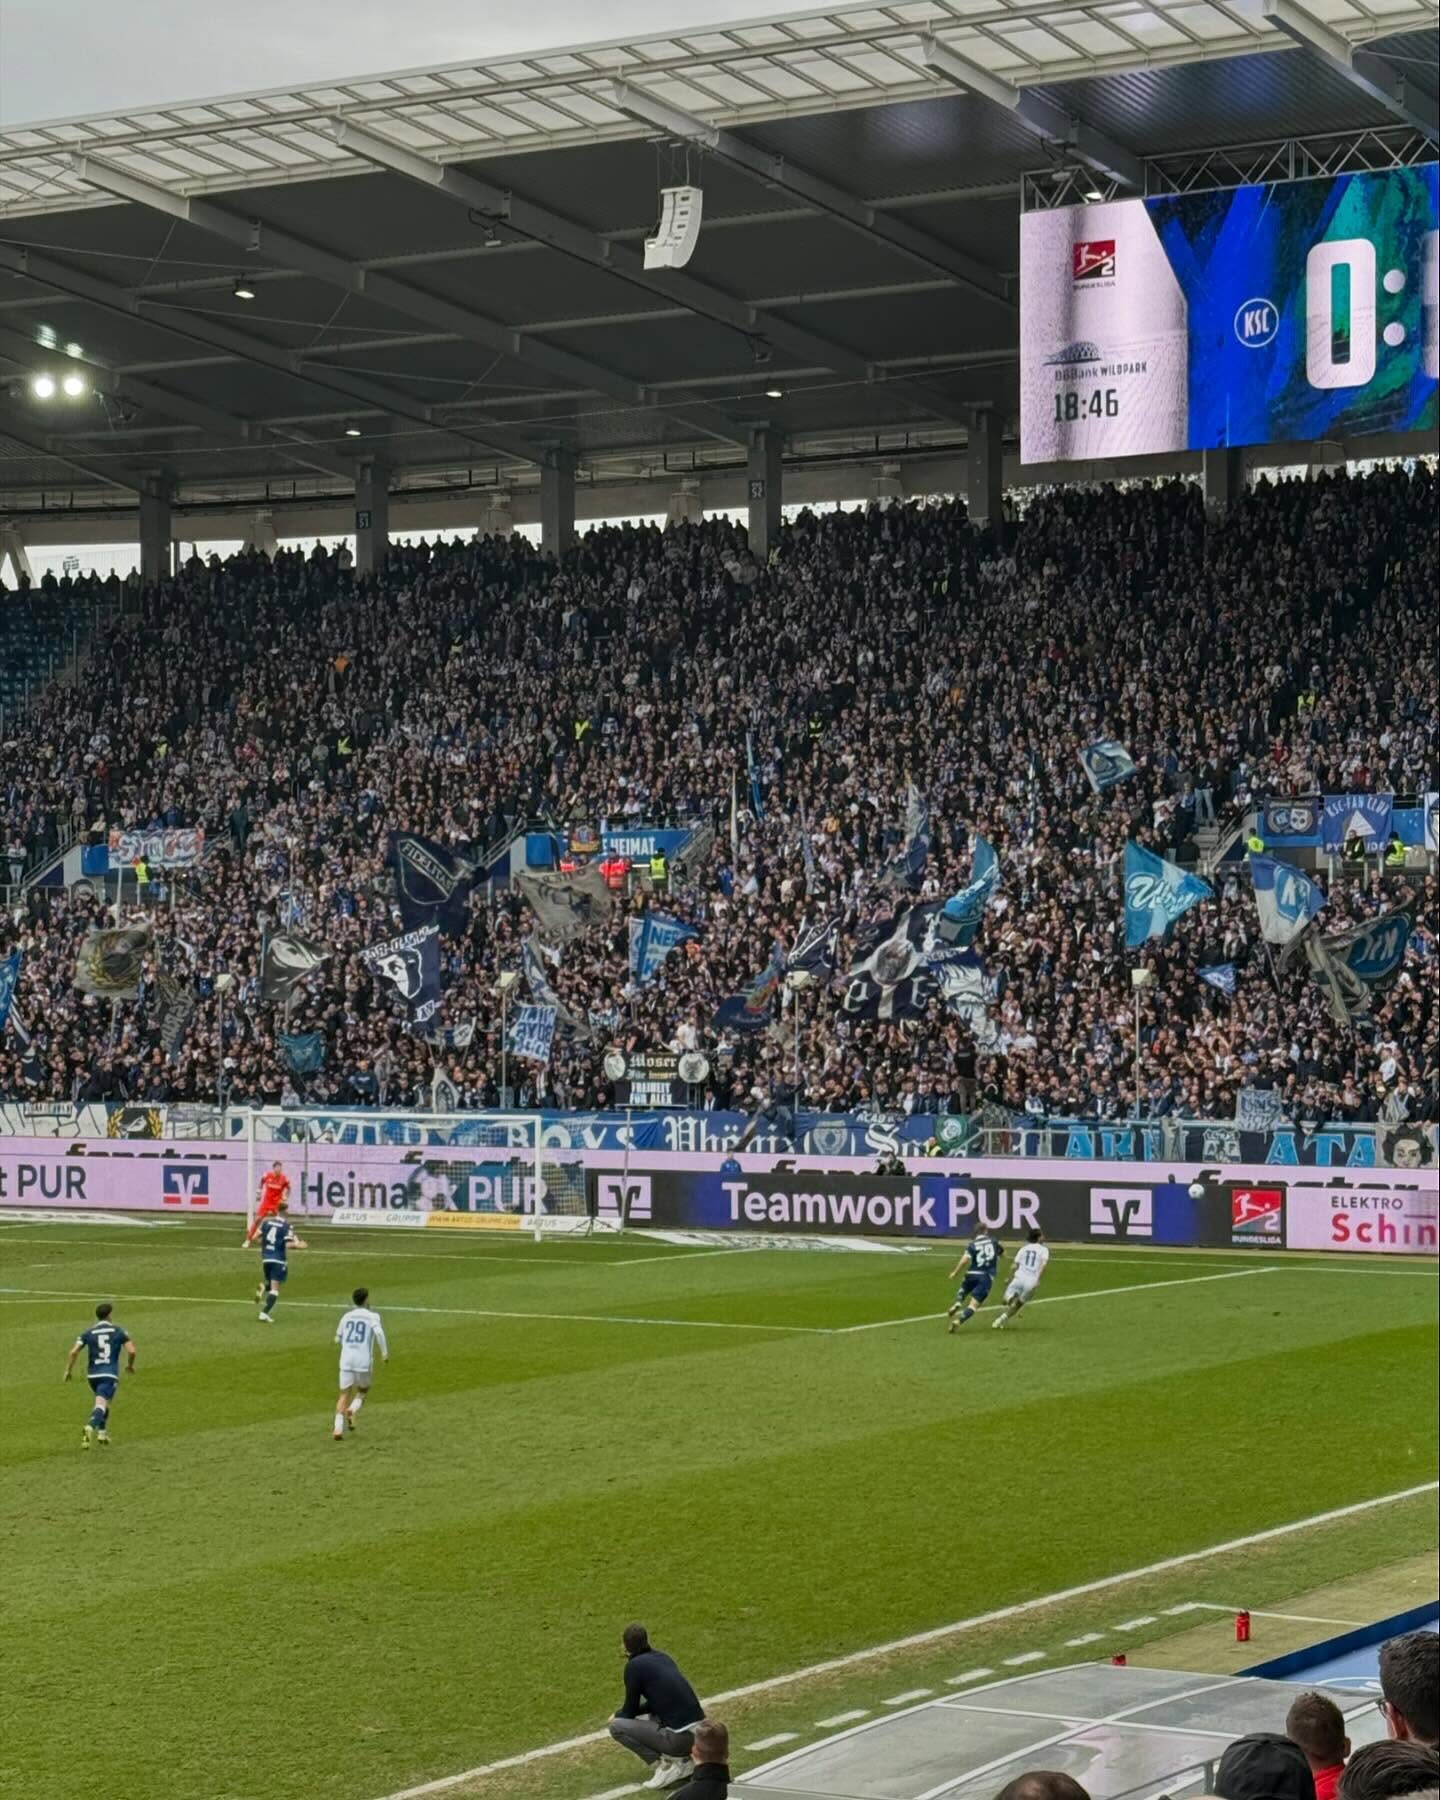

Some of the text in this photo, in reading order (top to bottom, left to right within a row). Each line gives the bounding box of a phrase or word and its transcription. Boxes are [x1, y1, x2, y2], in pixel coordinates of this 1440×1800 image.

[1101, 258, 1114, 275] 2
[1244, 307, 1270, 338] KSC
[1306, 238, 1439, 389] 0:
[1100, 361, 1148, 377] WILDPARK
[1055, 389, 1119, 422] 18:46
[17, 1164, 88, 1199] PUR
[468, 1175, 548, 1213] PUR
[721, 1182, 1041, 1229] Teamwork PUR
[1331, 1196, 1404, 1211] ELEKTRO
[266, 1227, 277, 1244] 4
[1231, 1235, 1282, 1245] BUNDESLIGA
[975, 1242, 996, 1267] 29
[1025, 1250, 1037, 1267] 11
[345, 1320, 367, 1343] 29
[97, 1334, 111, 1360] 5
